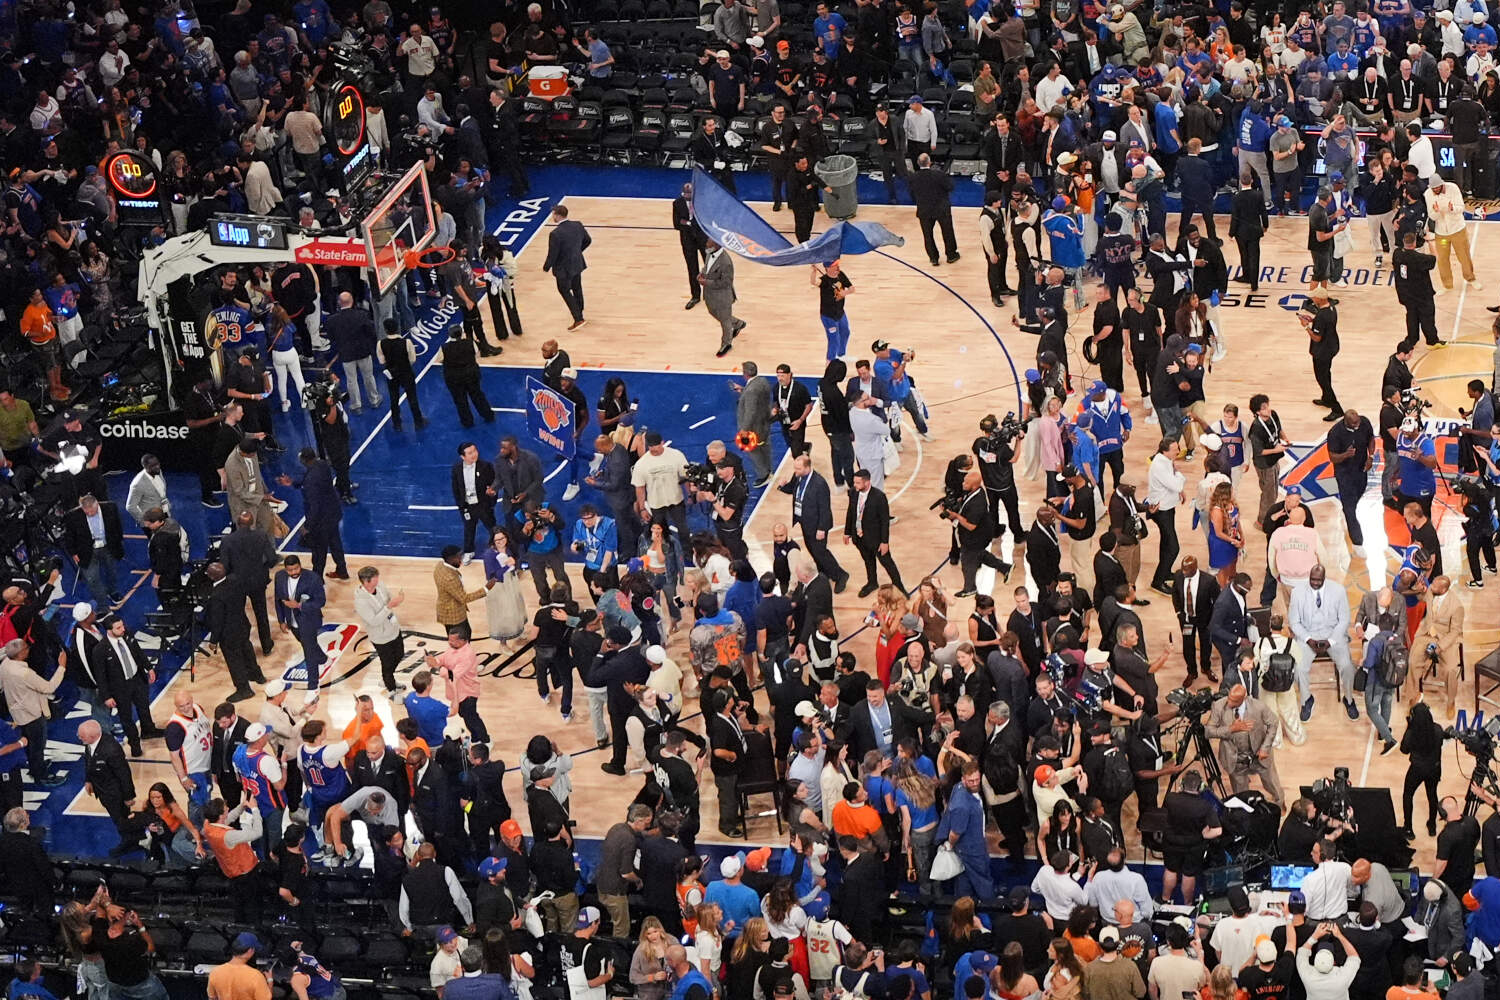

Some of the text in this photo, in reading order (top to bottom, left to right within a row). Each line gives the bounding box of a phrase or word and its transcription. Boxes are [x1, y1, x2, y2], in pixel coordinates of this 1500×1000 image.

[540, 81, 551, 91] G
[350, 144, 370, 169] TISSOT
[121, 163, 142, 178] 0.0
[130, 200, 159, 208] TISSOT
[493, 196, 550, 247] LTRA
[228, 226, 250, 245] App
[215, 311, 241, 323] EWING
[180, 321, 196, 333] GET
[216, 322, 242, 343] 33
[182, 333, 199, 345] THE
[189, 345, 205, 359] App
[99, 420, 190, 439] coinbase
[538, 427, 565, 452] WIN!
[810, 937, 830, 954] 32
